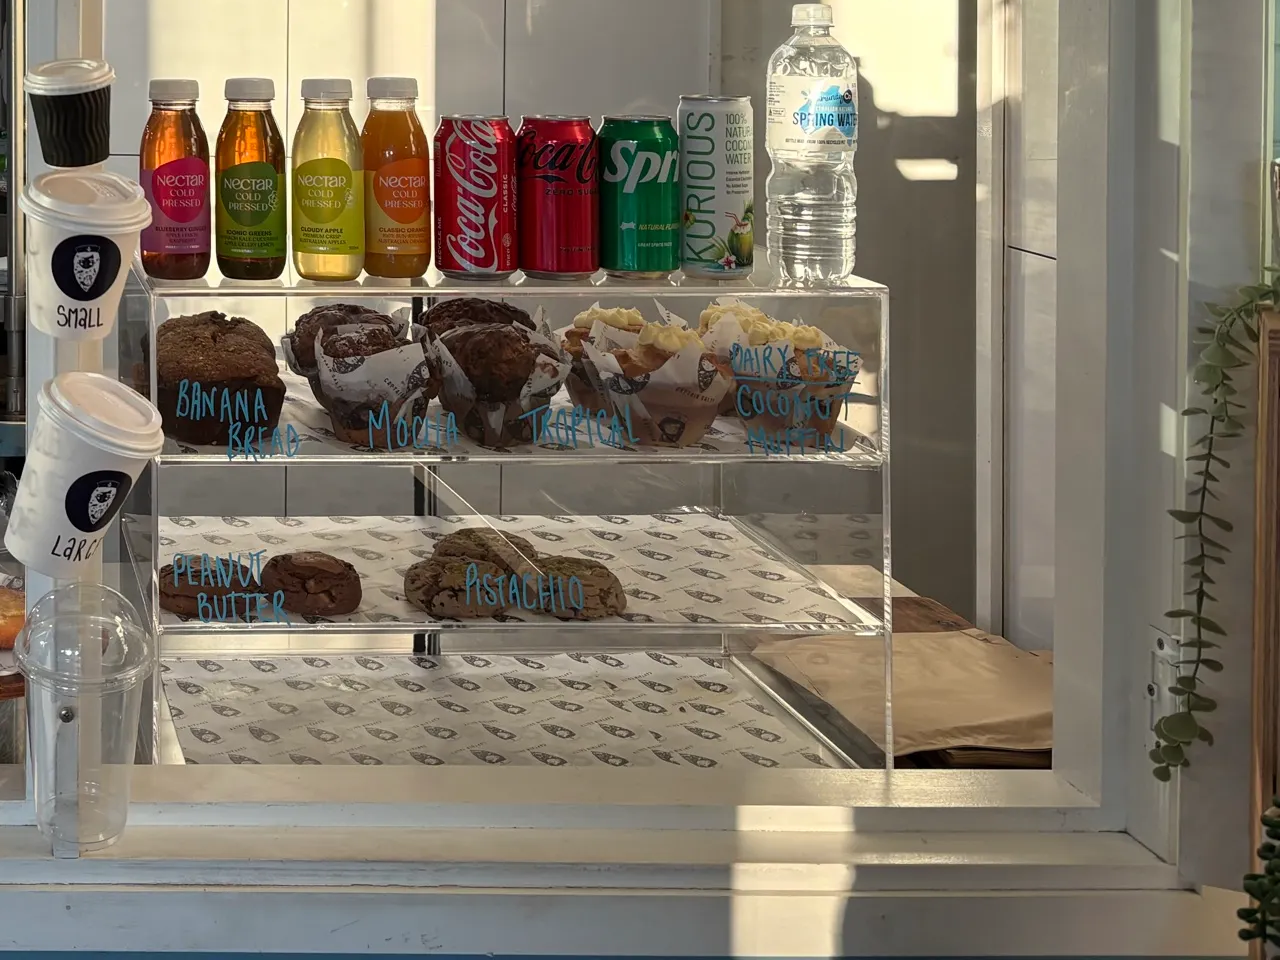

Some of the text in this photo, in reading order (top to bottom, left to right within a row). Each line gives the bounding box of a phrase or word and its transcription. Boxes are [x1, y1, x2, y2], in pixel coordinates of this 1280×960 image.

[725, 113, 747, 125] 100%
[725, 153, 752, 166] WATER
[170, 189, 195, 197] COLD
[308, 189, 333, 198] COLD
[545, 187, 573, 195] ZERO
[686, 112, 716, 263] KURIOUS
[235, 192, 261, 201] COLD
[392, 190, 417, 198] COLD
[163, 199, 200, 207] PRESSED
[228, 201, 268, 211] PRESSED
[302, 199, 341, 208] PRESSED
[384, 200, 423, 208] PRESSED
[638, 223, 665, 231] NATURAL
[731, 343, 861, 380] DAIRY FREE
[176, 378, 269, 423] BANANA
[736, 384, 868, 421] COCONUT
[518, 404, 640, 449] TROPICAL
[227, 421, 300, 462] BREAD
[746, 427, 846, 456] MUFFIN
[173, 549, 267, 588] PEANUT
[465, 562, 585, 612] PISTACHIO
[197, 589, 291, 627] BUTTER
